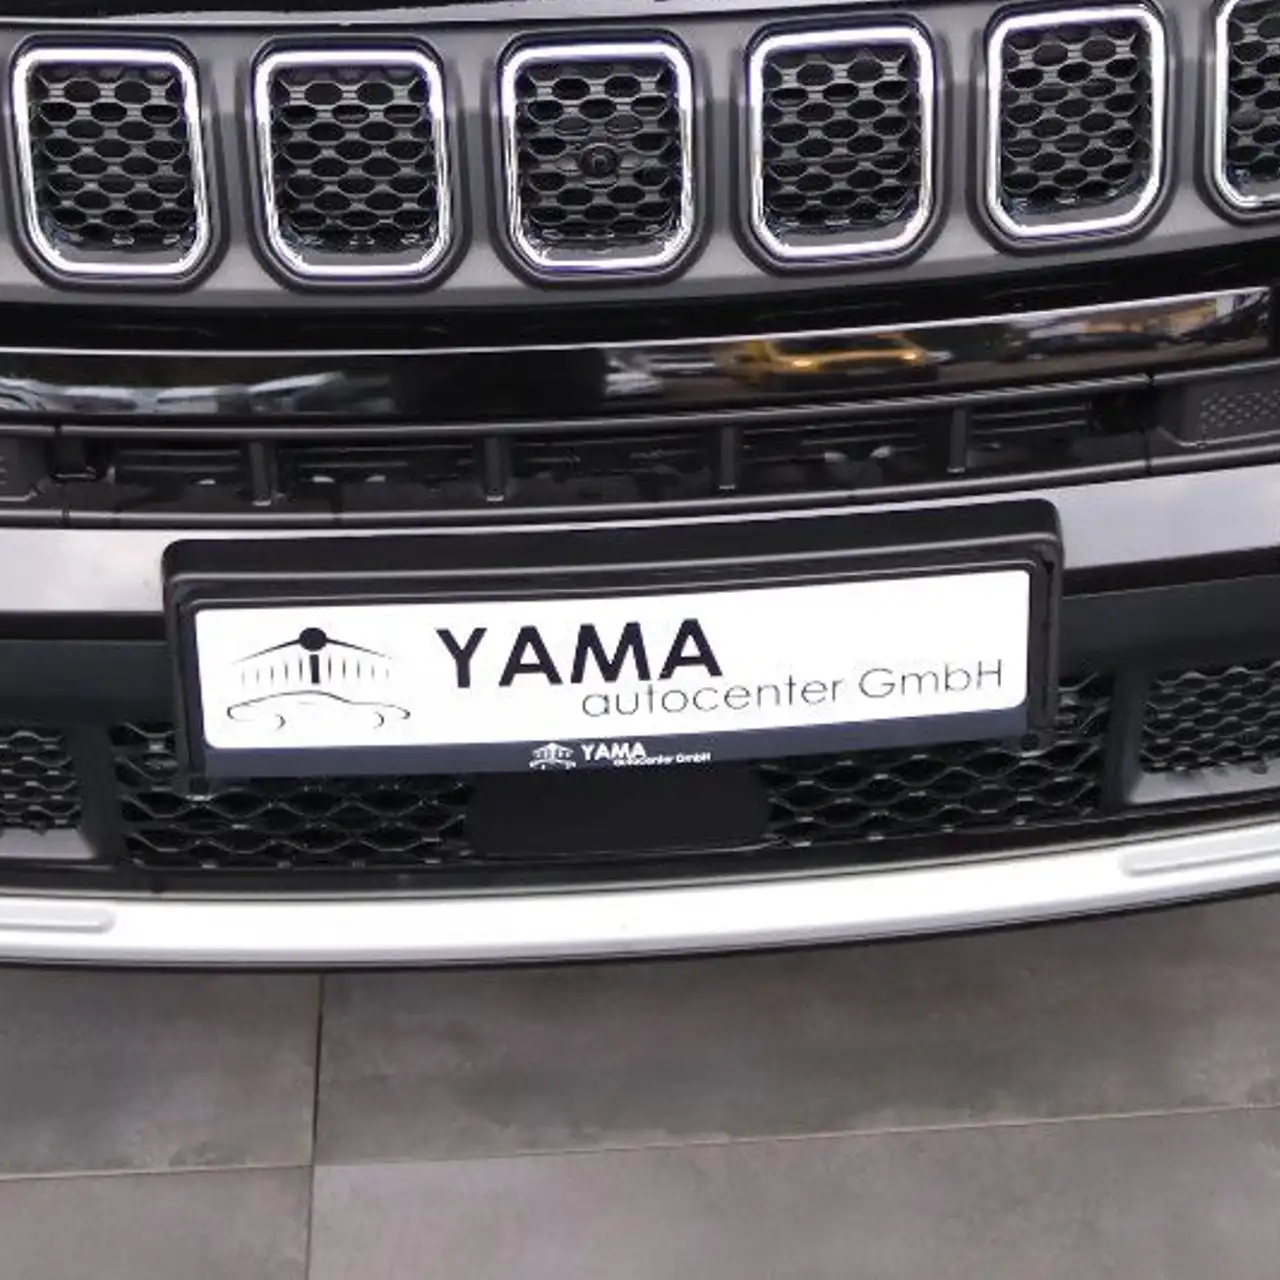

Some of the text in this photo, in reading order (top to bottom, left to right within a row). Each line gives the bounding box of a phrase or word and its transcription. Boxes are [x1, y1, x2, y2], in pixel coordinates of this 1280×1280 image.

[435, 617, 724, 690] YAMA
[581, 658, 1003, 718] autocenter GmbH
[580, 741, 646, 761] YAMA
[675, 751, 712, 764] GmbH
